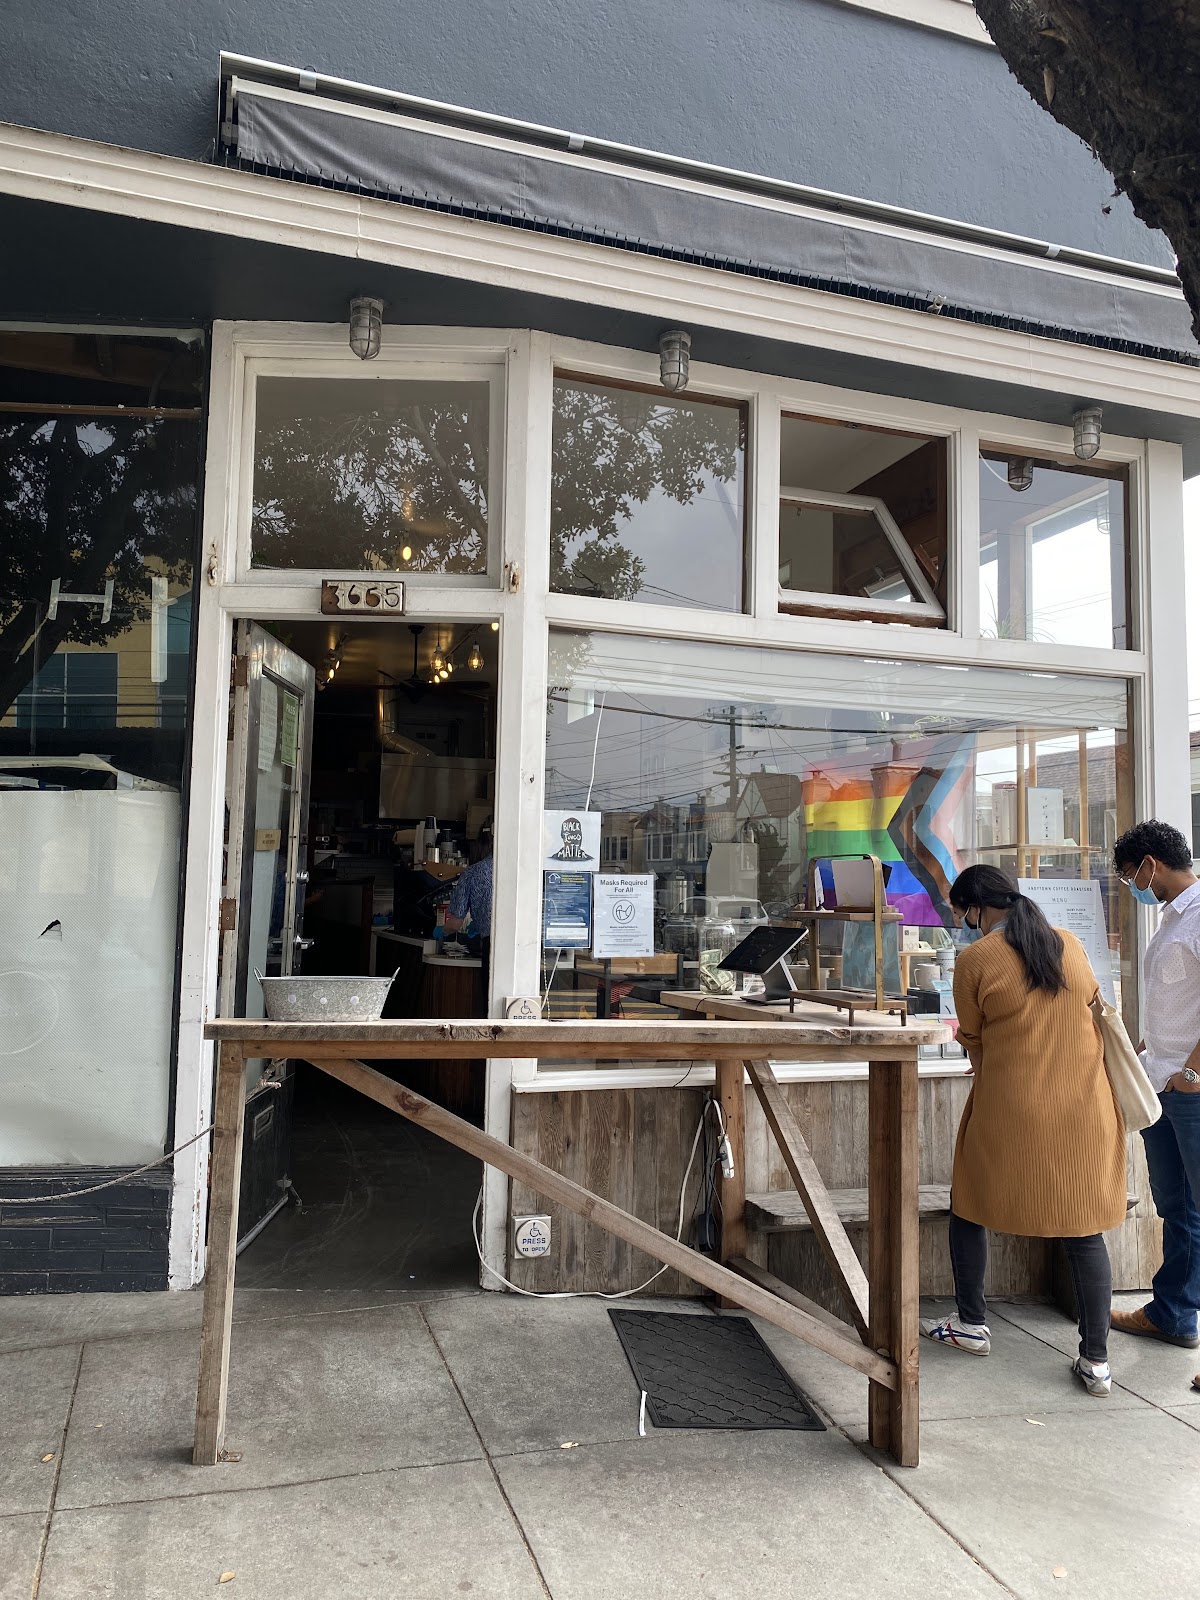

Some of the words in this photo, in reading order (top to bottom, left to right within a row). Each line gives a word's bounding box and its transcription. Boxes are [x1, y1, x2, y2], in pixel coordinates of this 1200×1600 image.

[324, 583, 399, 608] 3665
[563, 821, 581, 832] BLACK
[557, 844, 588, 859] MATTER
